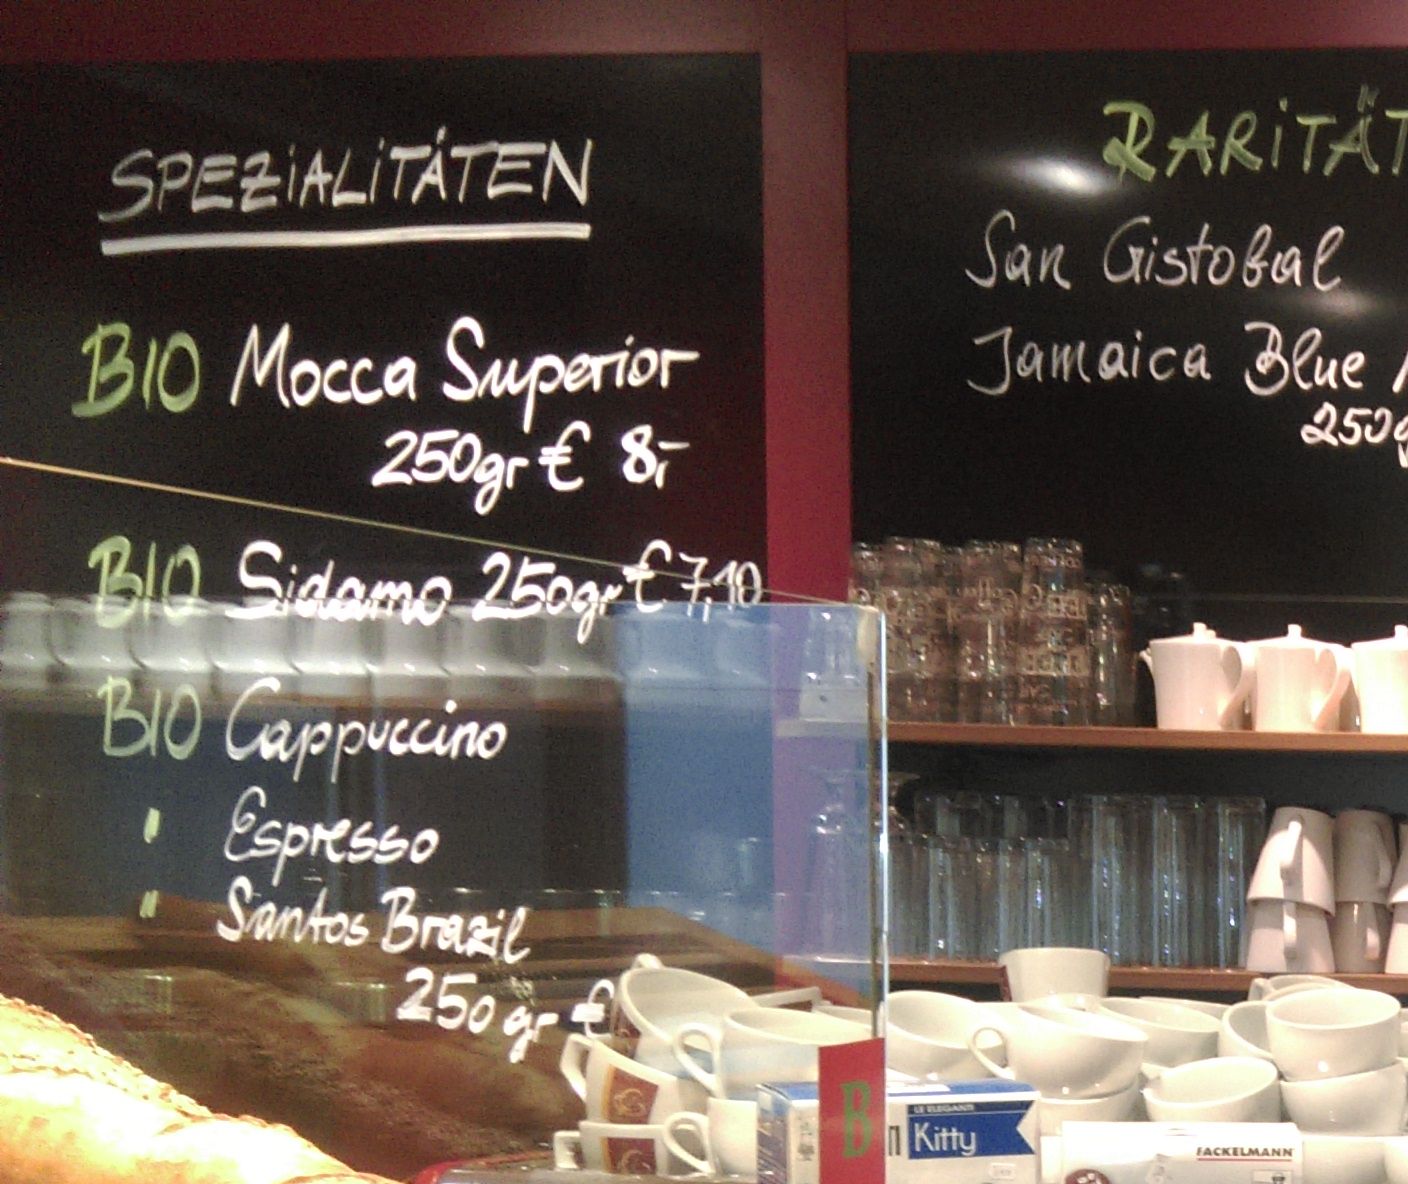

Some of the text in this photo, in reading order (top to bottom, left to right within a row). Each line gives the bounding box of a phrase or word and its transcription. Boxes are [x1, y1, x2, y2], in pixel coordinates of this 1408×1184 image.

[98, 126, 591, 224] SPEZIALITÄTEN
[965, 210, 1071, 290] San
[72, 317, 699, 432] BIO Mocca Superior
[967, 326, 1212, 396] Jamaica
[1244, 321, 1365, 396] Blue
[372, 430, 529, 515] 250gr
[89, 535, 201, 627] BIO
[226, 541, 451, 625] Sidamo
[98, 676, 507, 783] BIO Cappuccino
[224, 787, 439, 886] Espresso
[217, 876, 530, 964] Santos Brazil
[913, 1122, 977, 1157] Kitty
[1196, 1147, 1294, 1157] FACKELMANN
